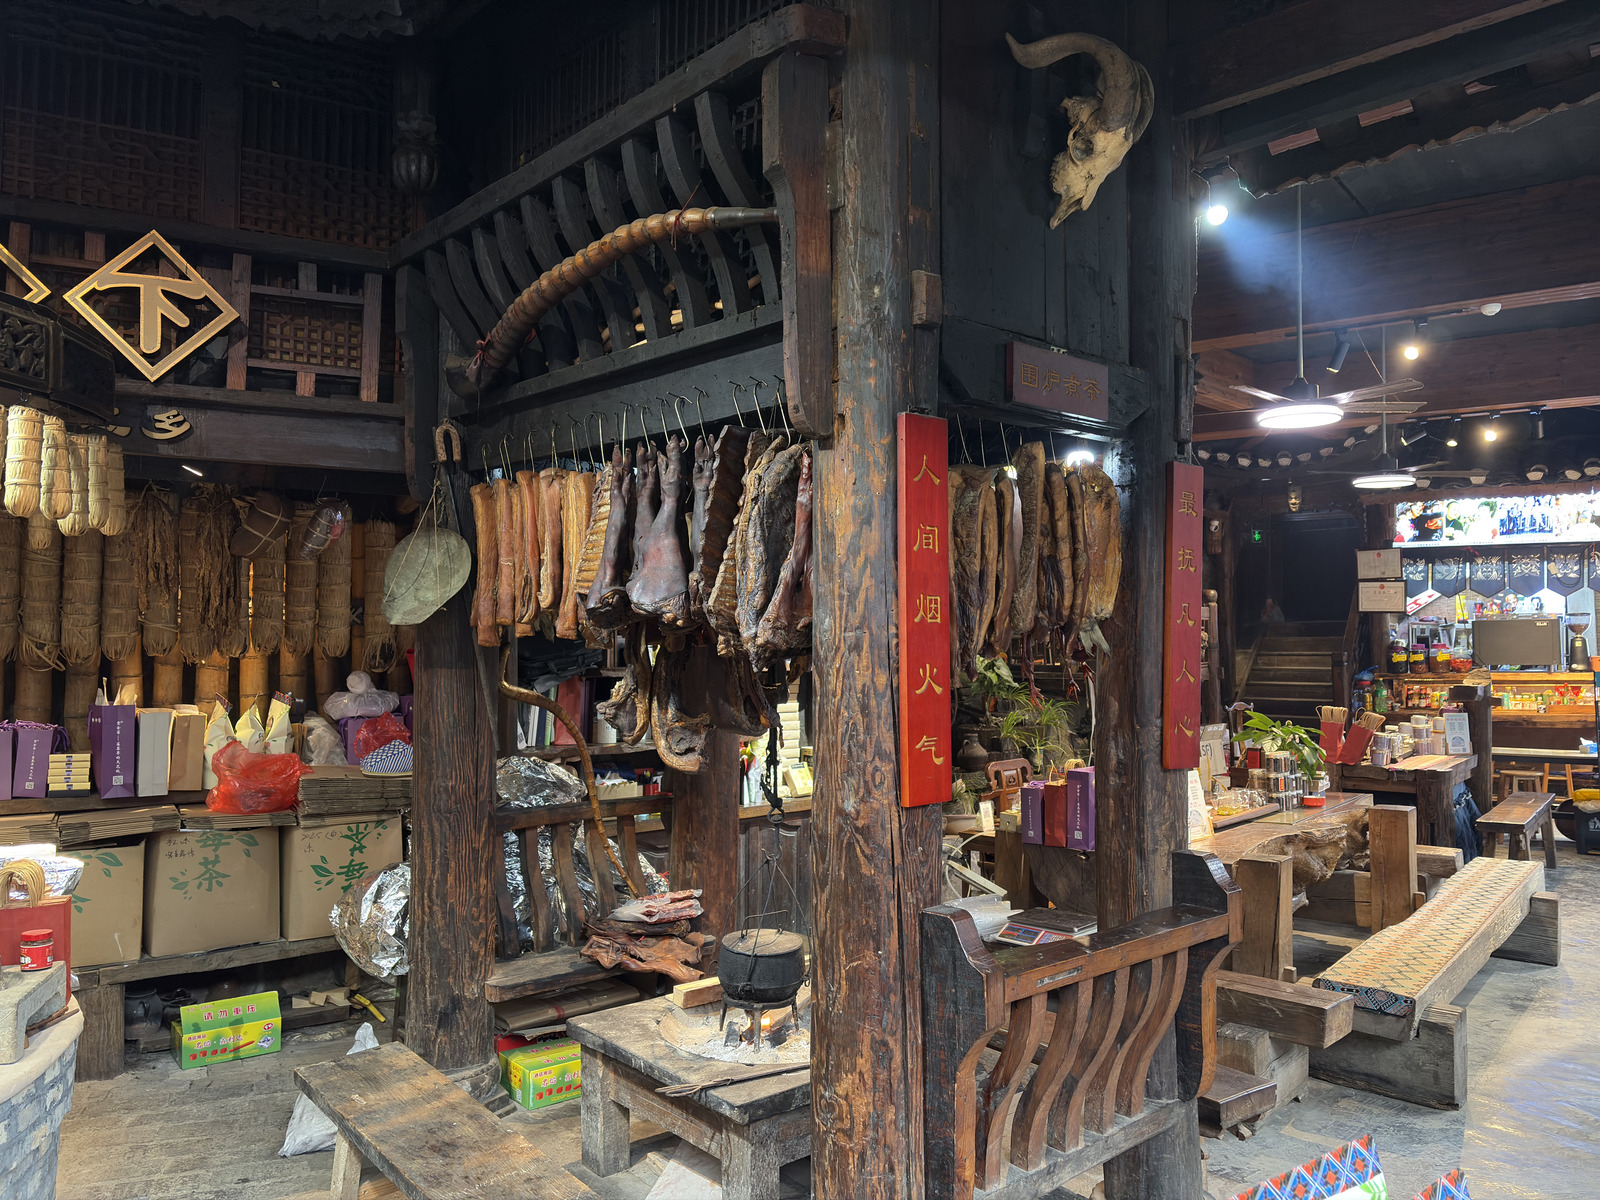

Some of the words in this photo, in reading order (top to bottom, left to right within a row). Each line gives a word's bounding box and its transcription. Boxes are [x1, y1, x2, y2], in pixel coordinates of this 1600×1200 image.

[1021, 361, 1102, 401] 围炉煮茶
[913, 454, 945, 765] 人间烟火气
[1174, 491, 1199, 738] 最抚凡人心
[203, 1004, 256, 1021] 请勿重压
